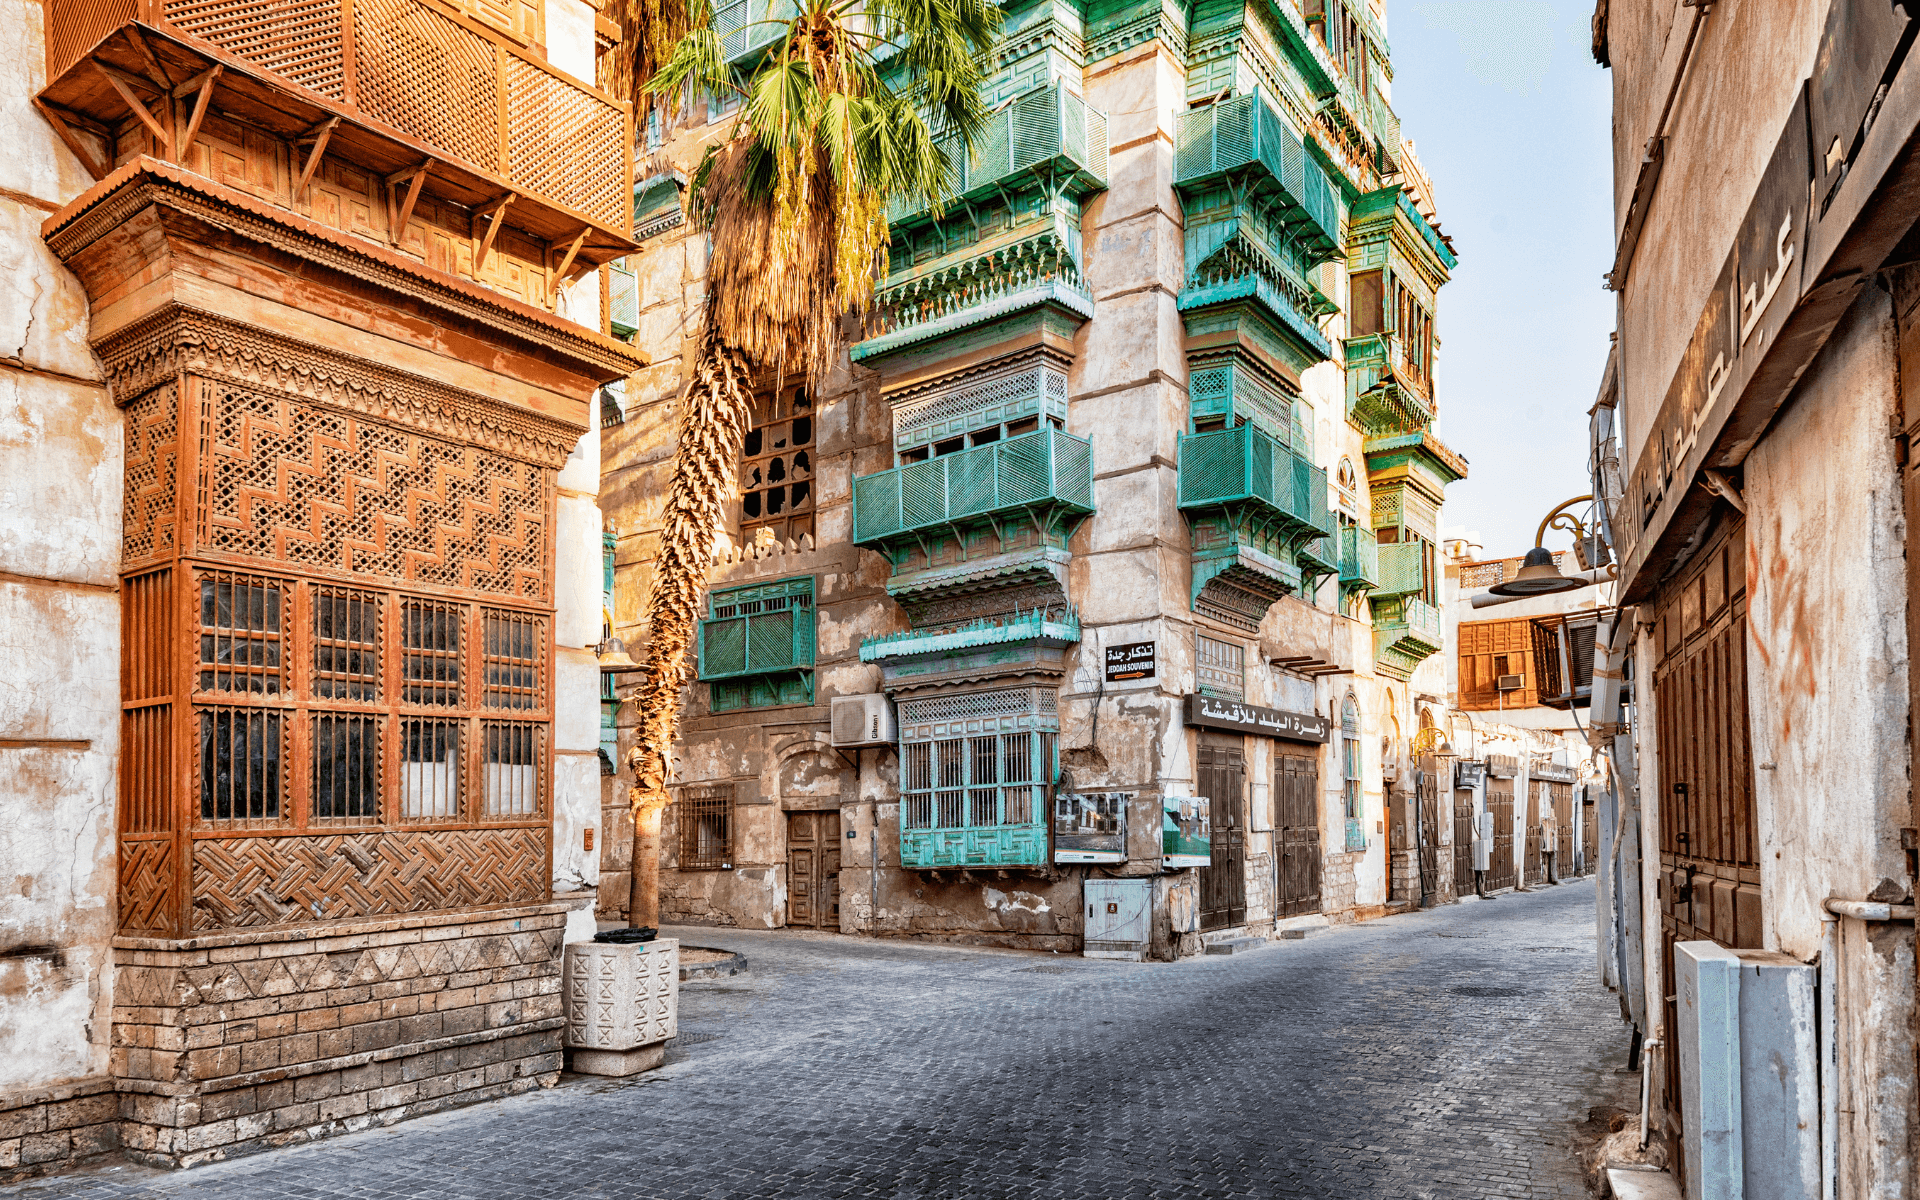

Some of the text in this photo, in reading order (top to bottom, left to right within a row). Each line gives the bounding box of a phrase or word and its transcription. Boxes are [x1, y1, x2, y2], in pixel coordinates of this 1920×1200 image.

[1107, 644, 1154, 662] تذكار جدة
[1107, 660, 1154, 673] JEDDAH SOUVENIR
[1200, 698, 1325, 738] زهرة البلد للأقمشة
